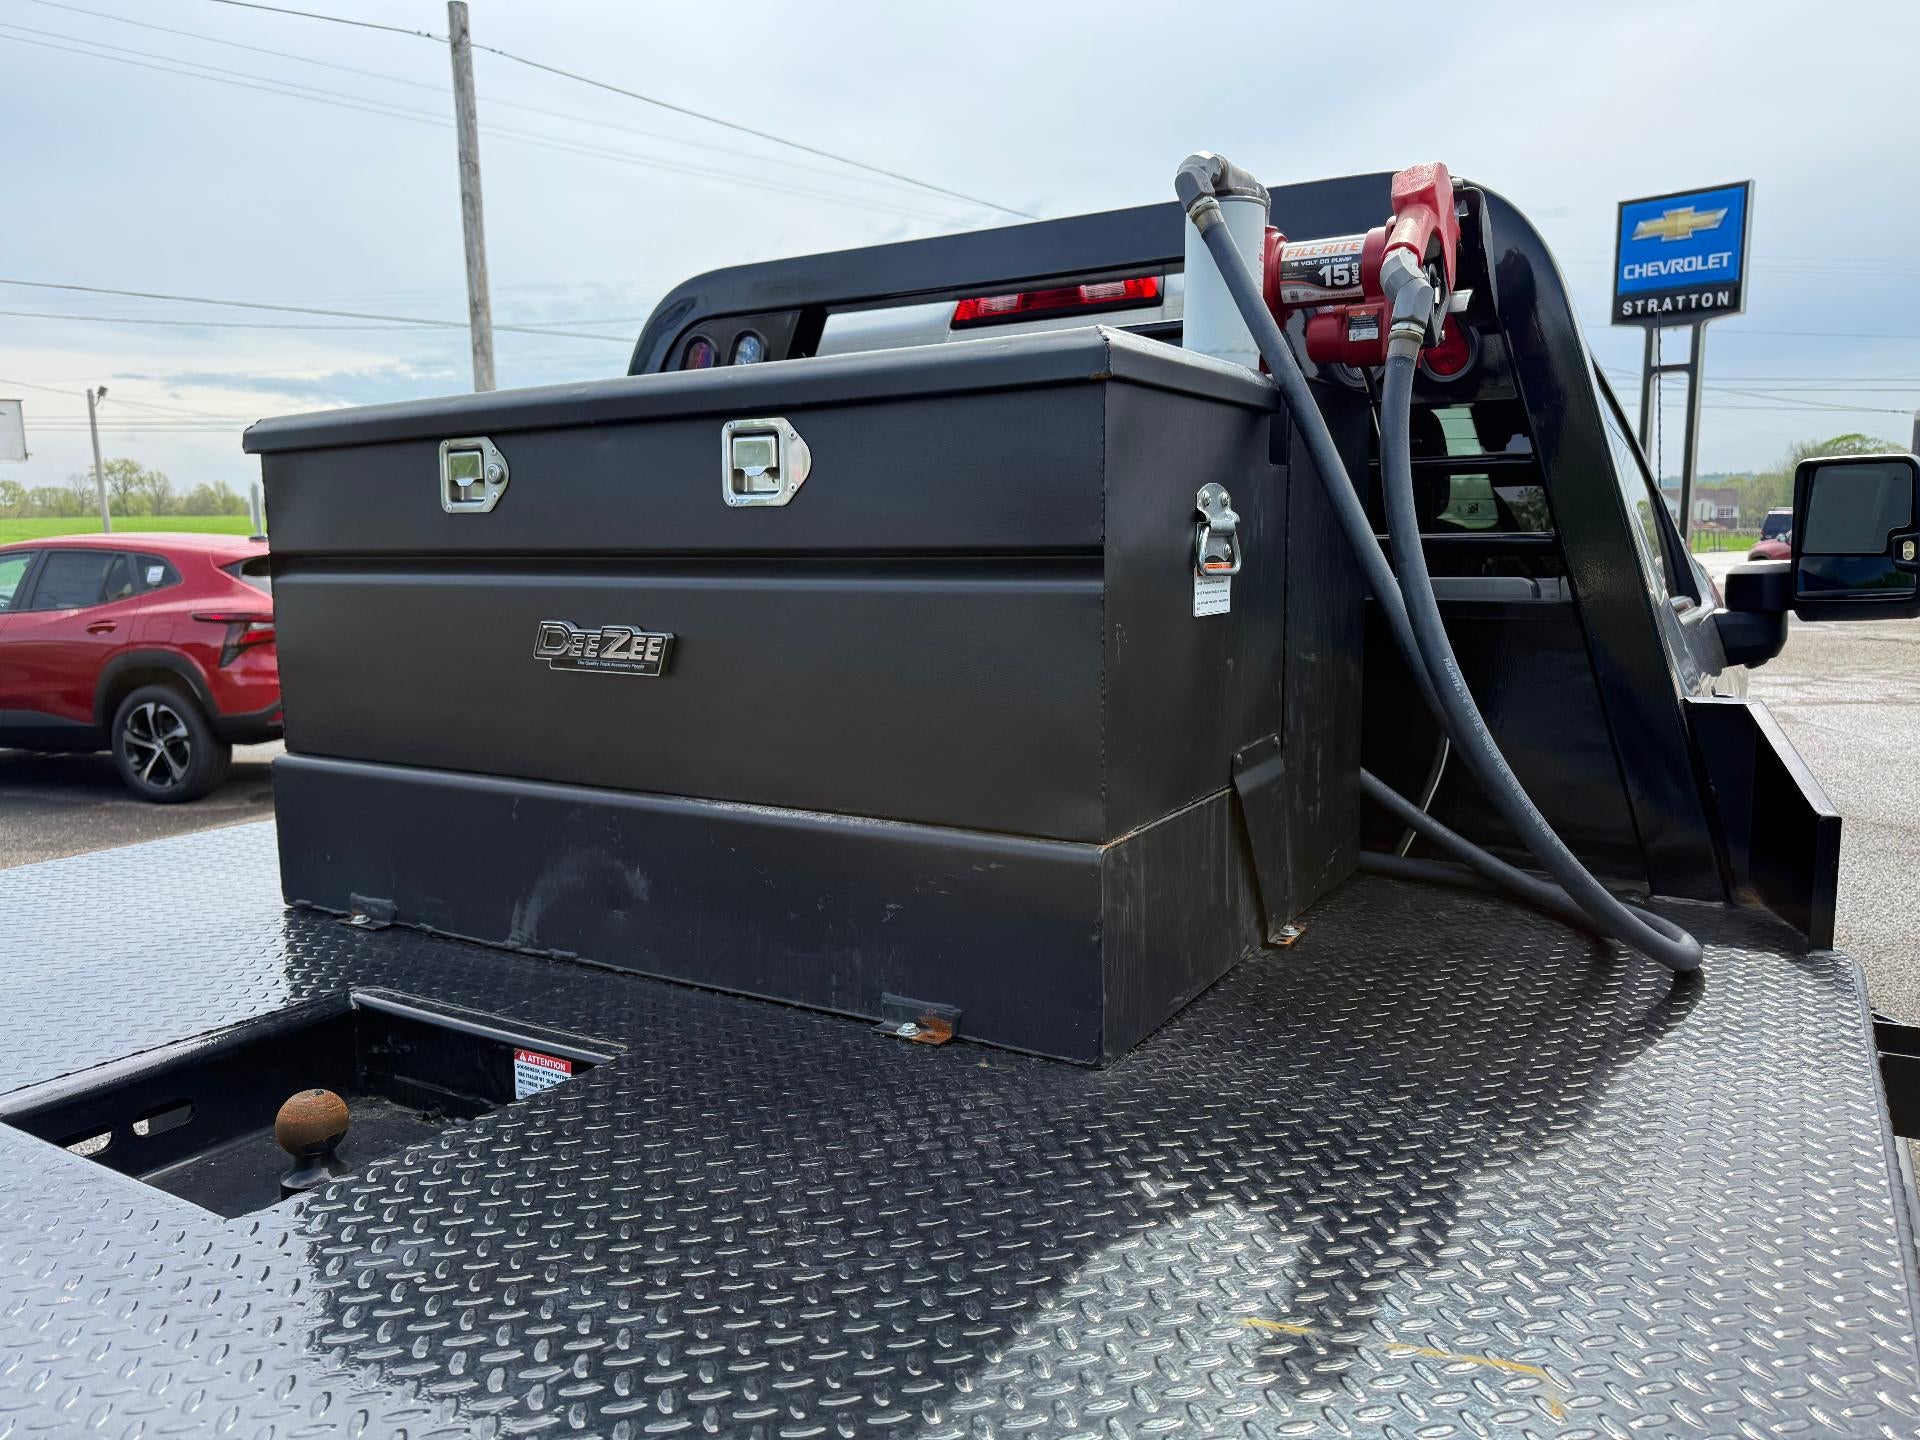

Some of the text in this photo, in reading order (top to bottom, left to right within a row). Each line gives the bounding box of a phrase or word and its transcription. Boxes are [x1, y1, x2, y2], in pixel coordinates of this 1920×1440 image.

[1285, 241, 1361, 257] FILL-RITE
[1318, 263, 1350, 287] 15
[1351, 262, 1360, 285] GPM
[1623, 251, 1732, 280] CHEVROLET
[1622, 291, 1729, 316] STRATTON
[527, 1055, 566, 1072] ATTENTION
